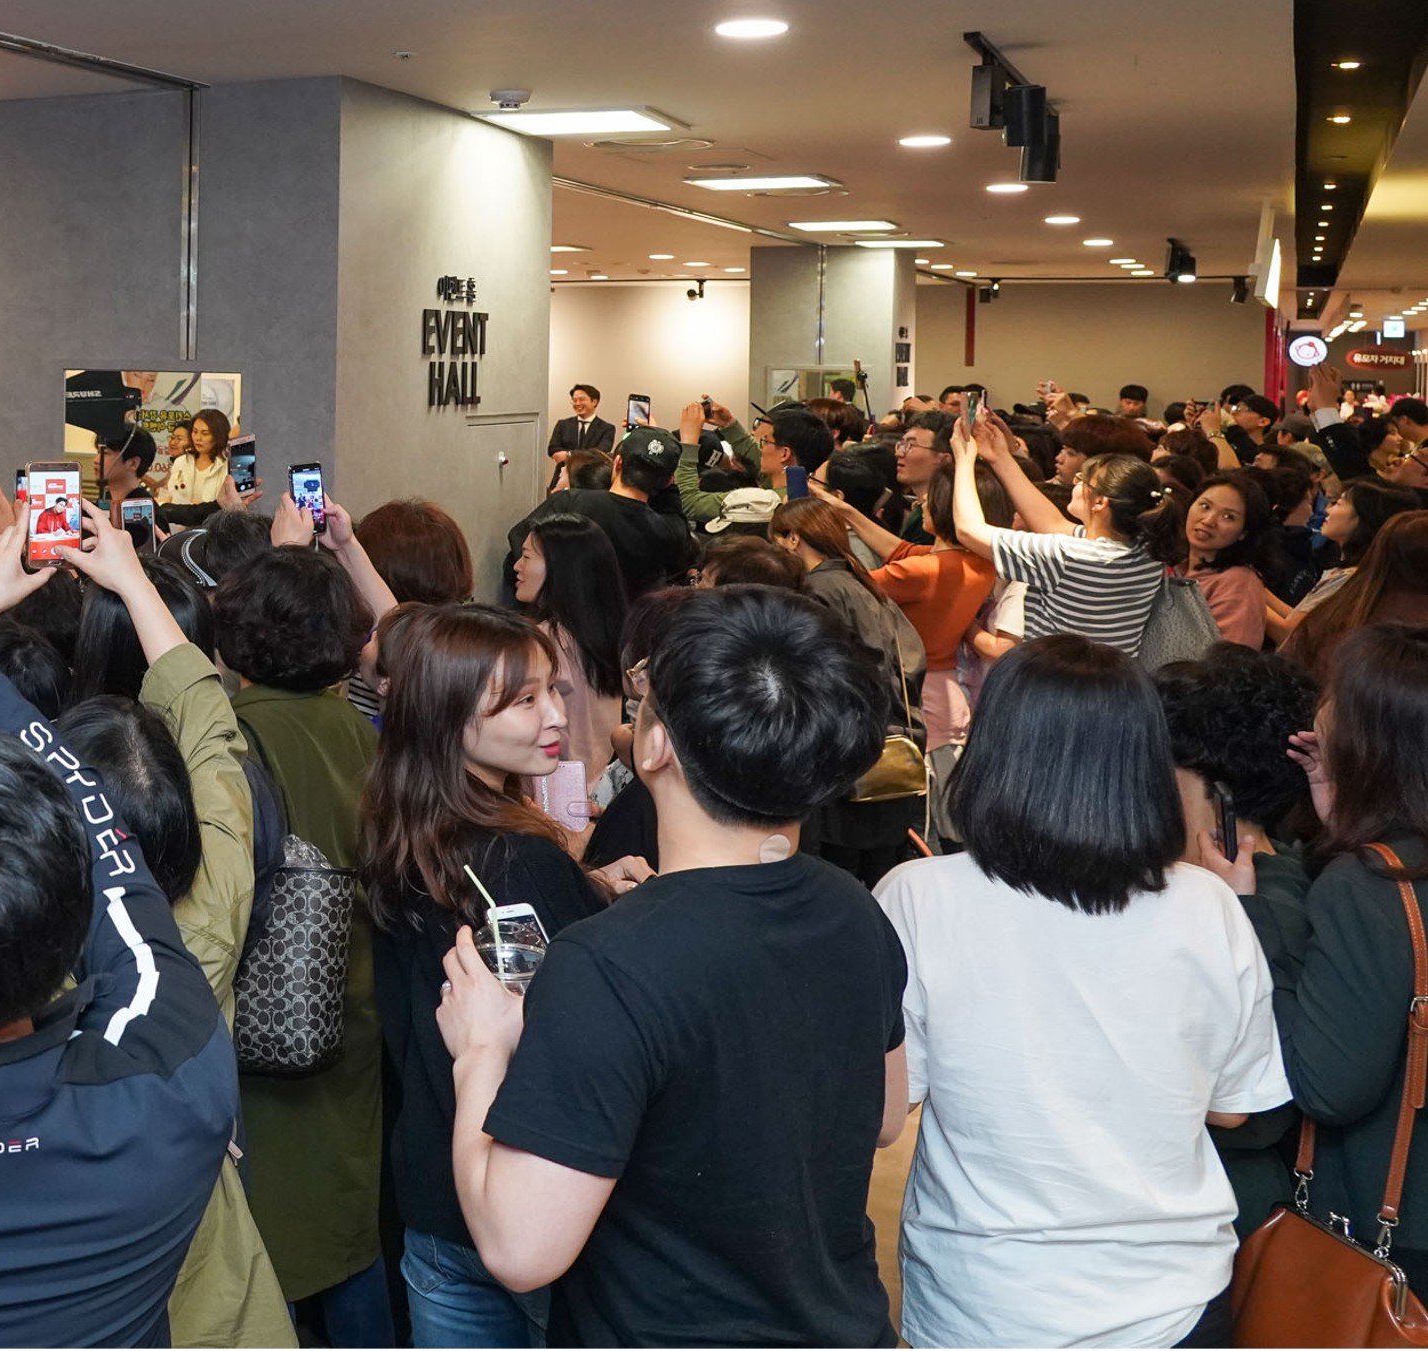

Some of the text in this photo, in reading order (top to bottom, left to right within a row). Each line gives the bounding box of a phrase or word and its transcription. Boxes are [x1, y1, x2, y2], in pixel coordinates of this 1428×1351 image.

[422, 309, 489, 355] EVENT
[1353, 353, 1405, 365] 유모차 거치대
[428, 361, 481, 406] HALL
[20, 721, 136, 877] SPYDER
